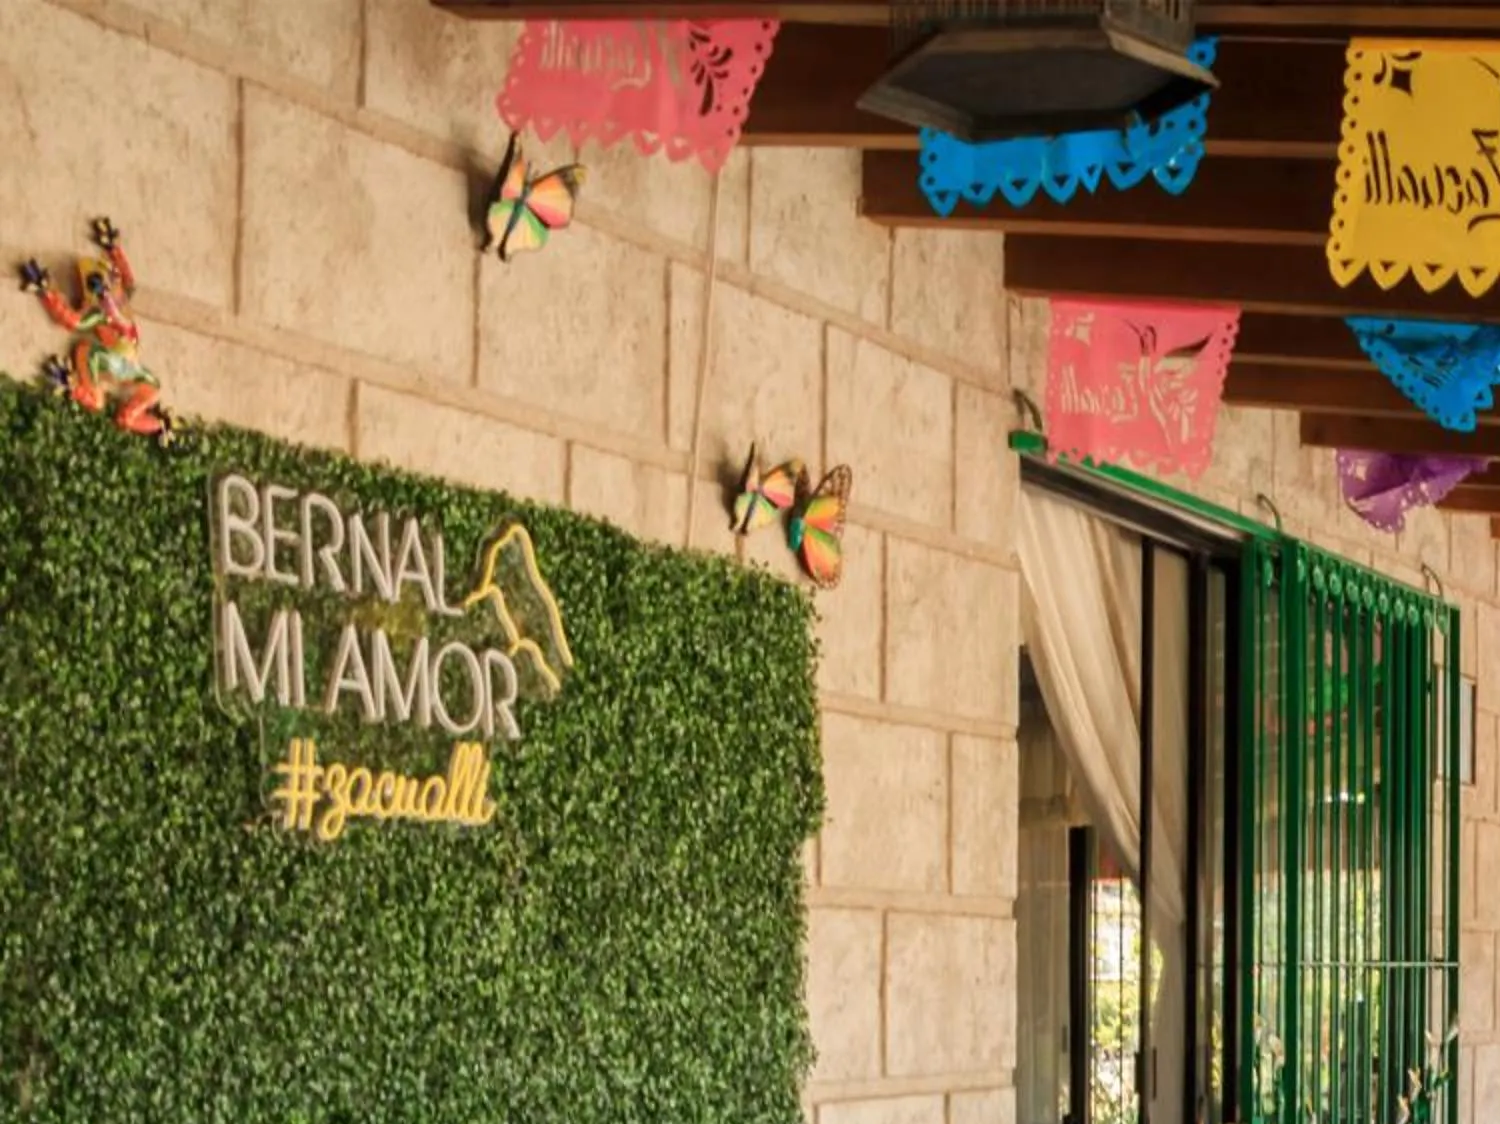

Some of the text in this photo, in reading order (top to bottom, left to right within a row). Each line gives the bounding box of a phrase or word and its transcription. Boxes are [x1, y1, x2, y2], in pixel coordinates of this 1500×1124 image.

[219, 473, 465, 617] BERNAL
[224, 601, 521, 740] MI AMOR
